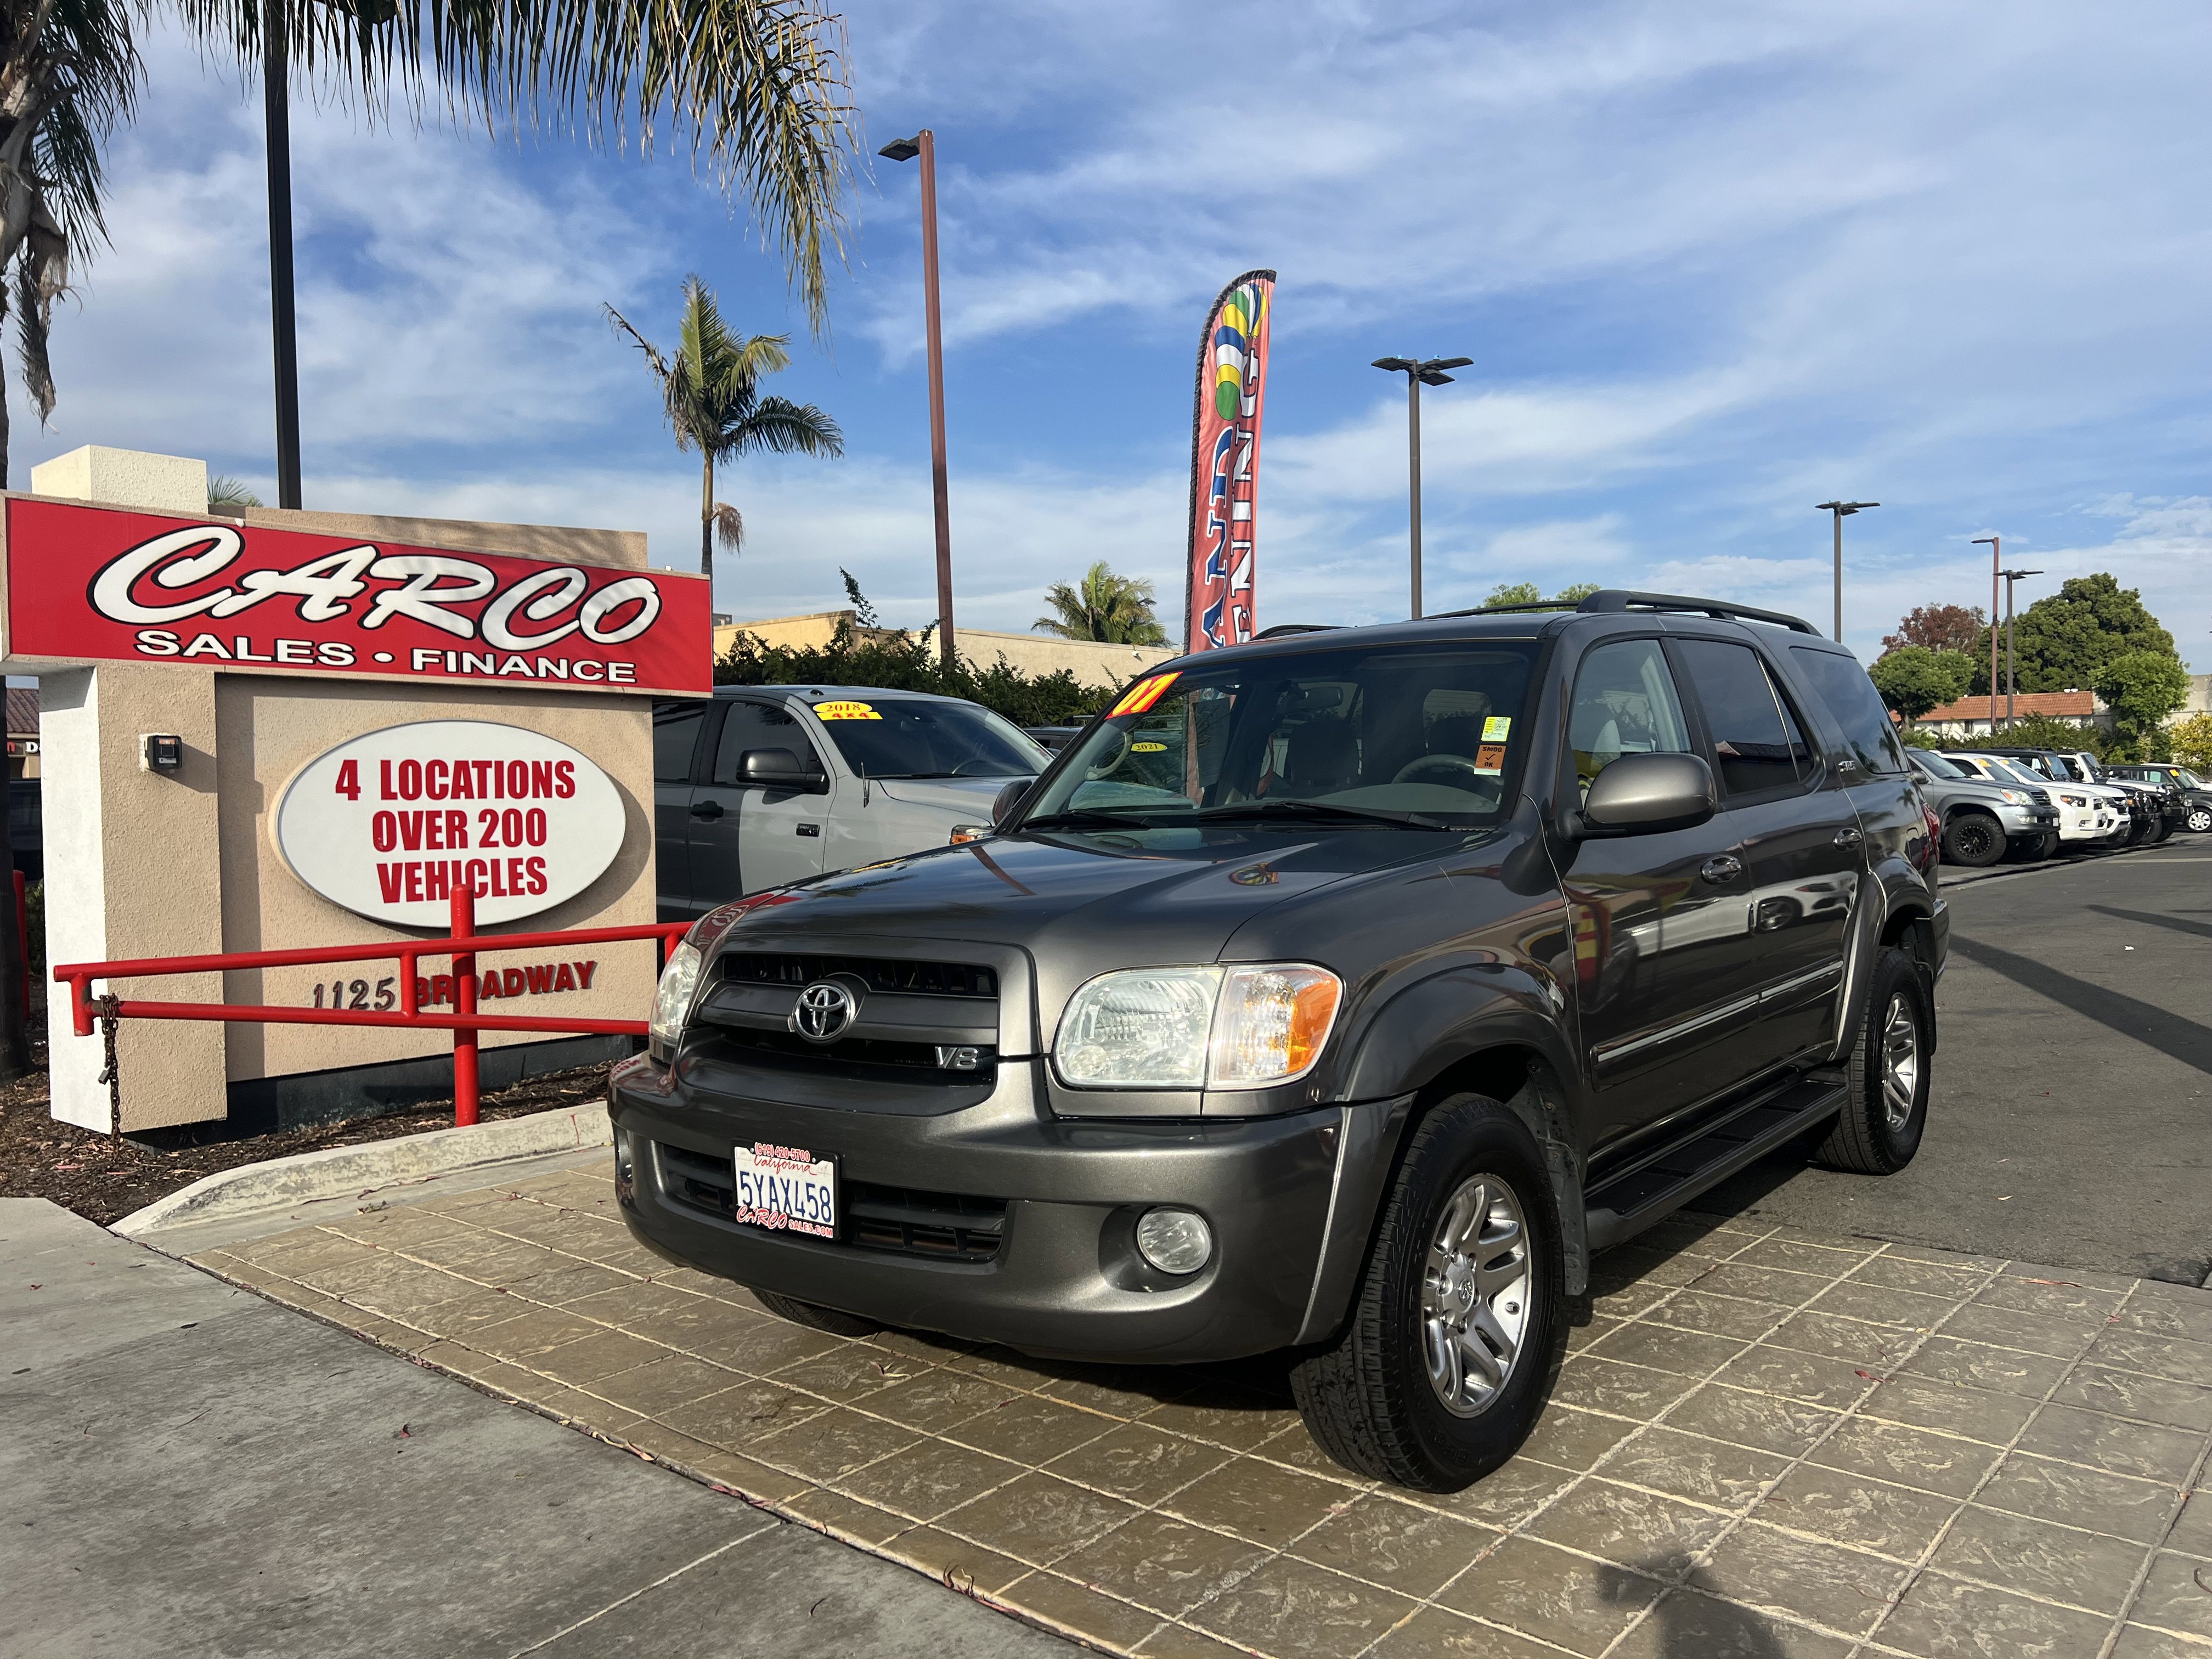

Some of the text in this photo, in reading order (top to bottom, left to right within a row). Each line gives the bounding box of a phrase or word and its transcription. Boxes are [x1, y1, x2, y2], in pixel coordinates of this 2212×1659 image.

[87, 524, 662, 651] CARCO
[136, 629, 638, 684] SALES FINANCE
[825, 703, 860, 712] 2018
[1113, 673, 1179, 716] 07
[336, 759, 576, 801] 4 LOCATIONS
[373, 808, 547, 853] OVER 200
[376, 856, 548, 904] VEHICLES
[313, 961, 596, 1011] 1125 BRADWAY
[934, 1046, 979, 1070] V8
[754, 1142, 810, 1163] (619) 420-5700
[754, 1154, 817, 1176] California
[740, 1170, 832, 1223] 5YAX458
[788, 1219, 833, 1239] SALES.COM
